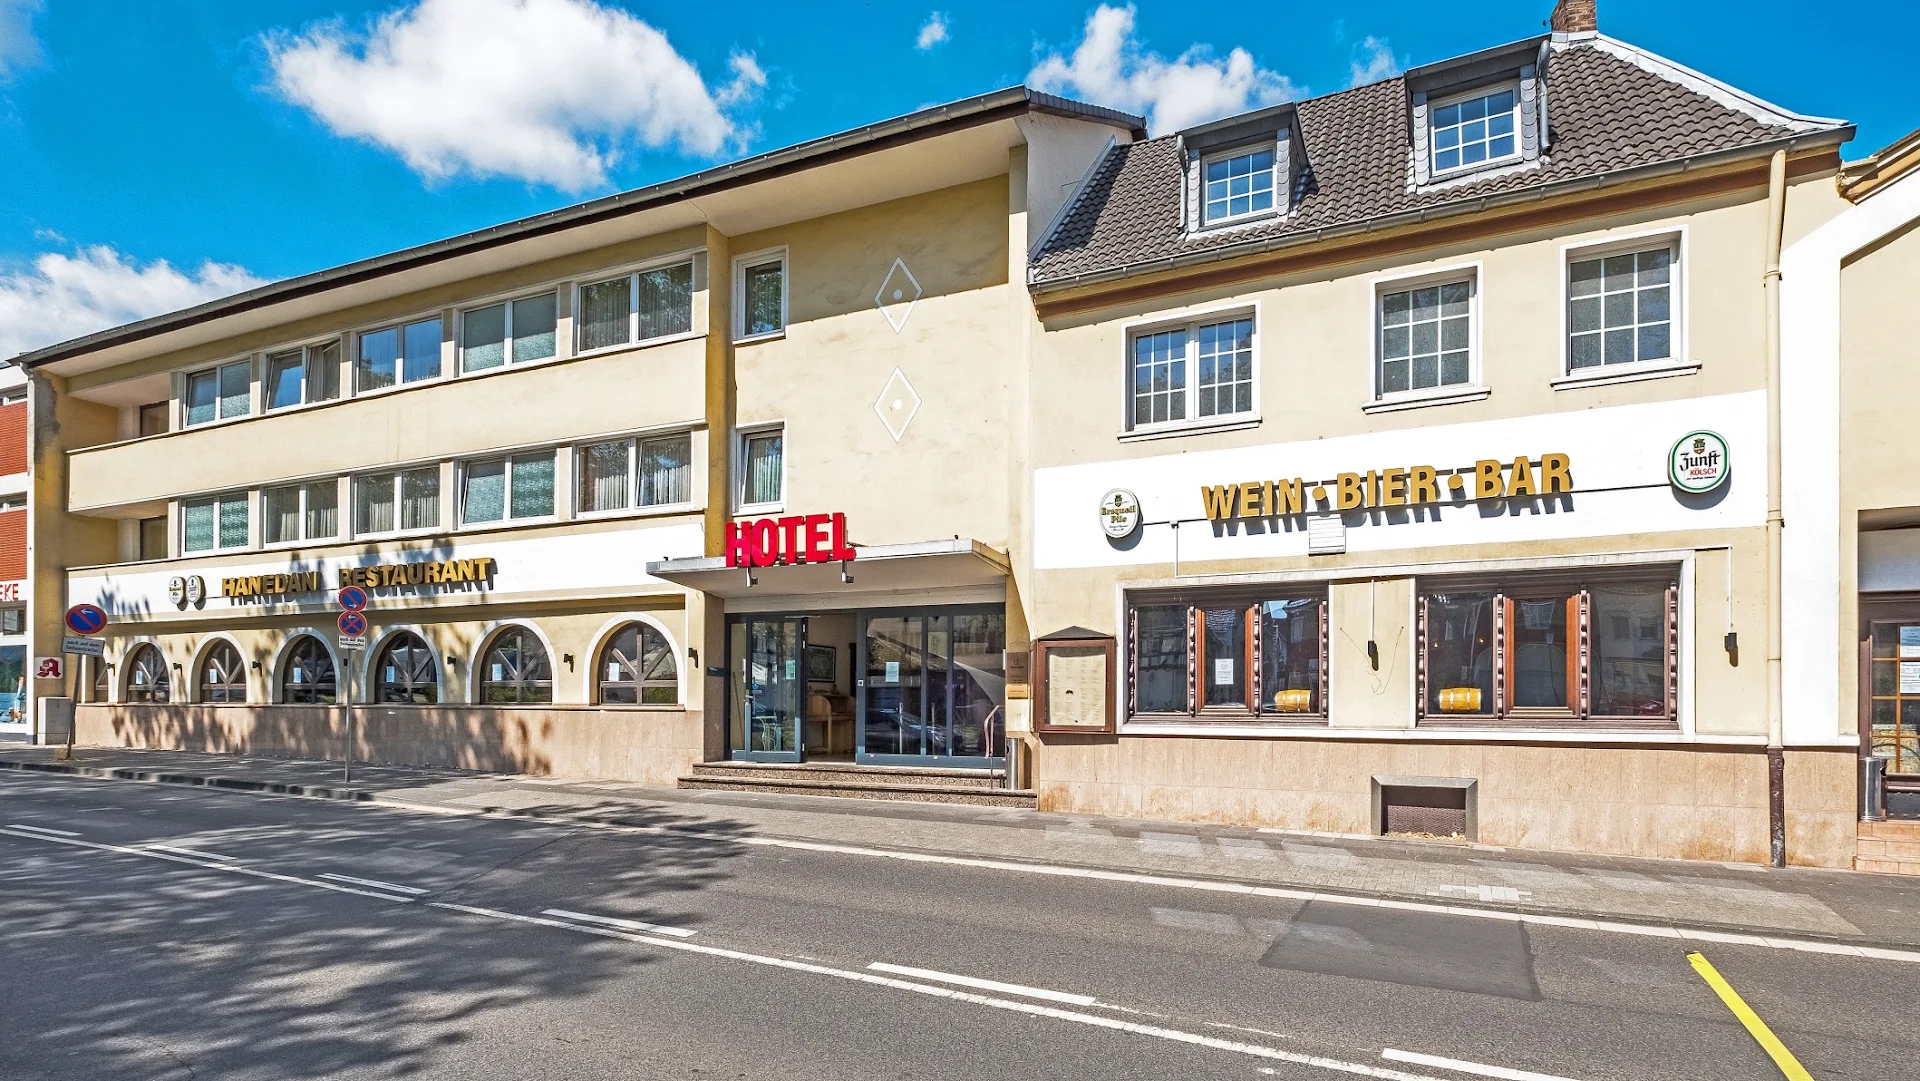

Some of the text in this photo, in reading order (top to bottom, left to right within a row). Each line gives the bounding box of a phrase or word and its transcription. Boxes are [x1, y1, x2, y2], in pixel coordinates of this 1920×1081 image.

[1679, 450, 1721, 471] Zunft
[1690, 467, 1717, 475] KÖLSCH
[1201, 453, 1571, 520] WEIN BIER BAR
[725, 512, 856, 568] HOTEL
[221, 557, 492, 597] HANEDAN RESTAURANT
